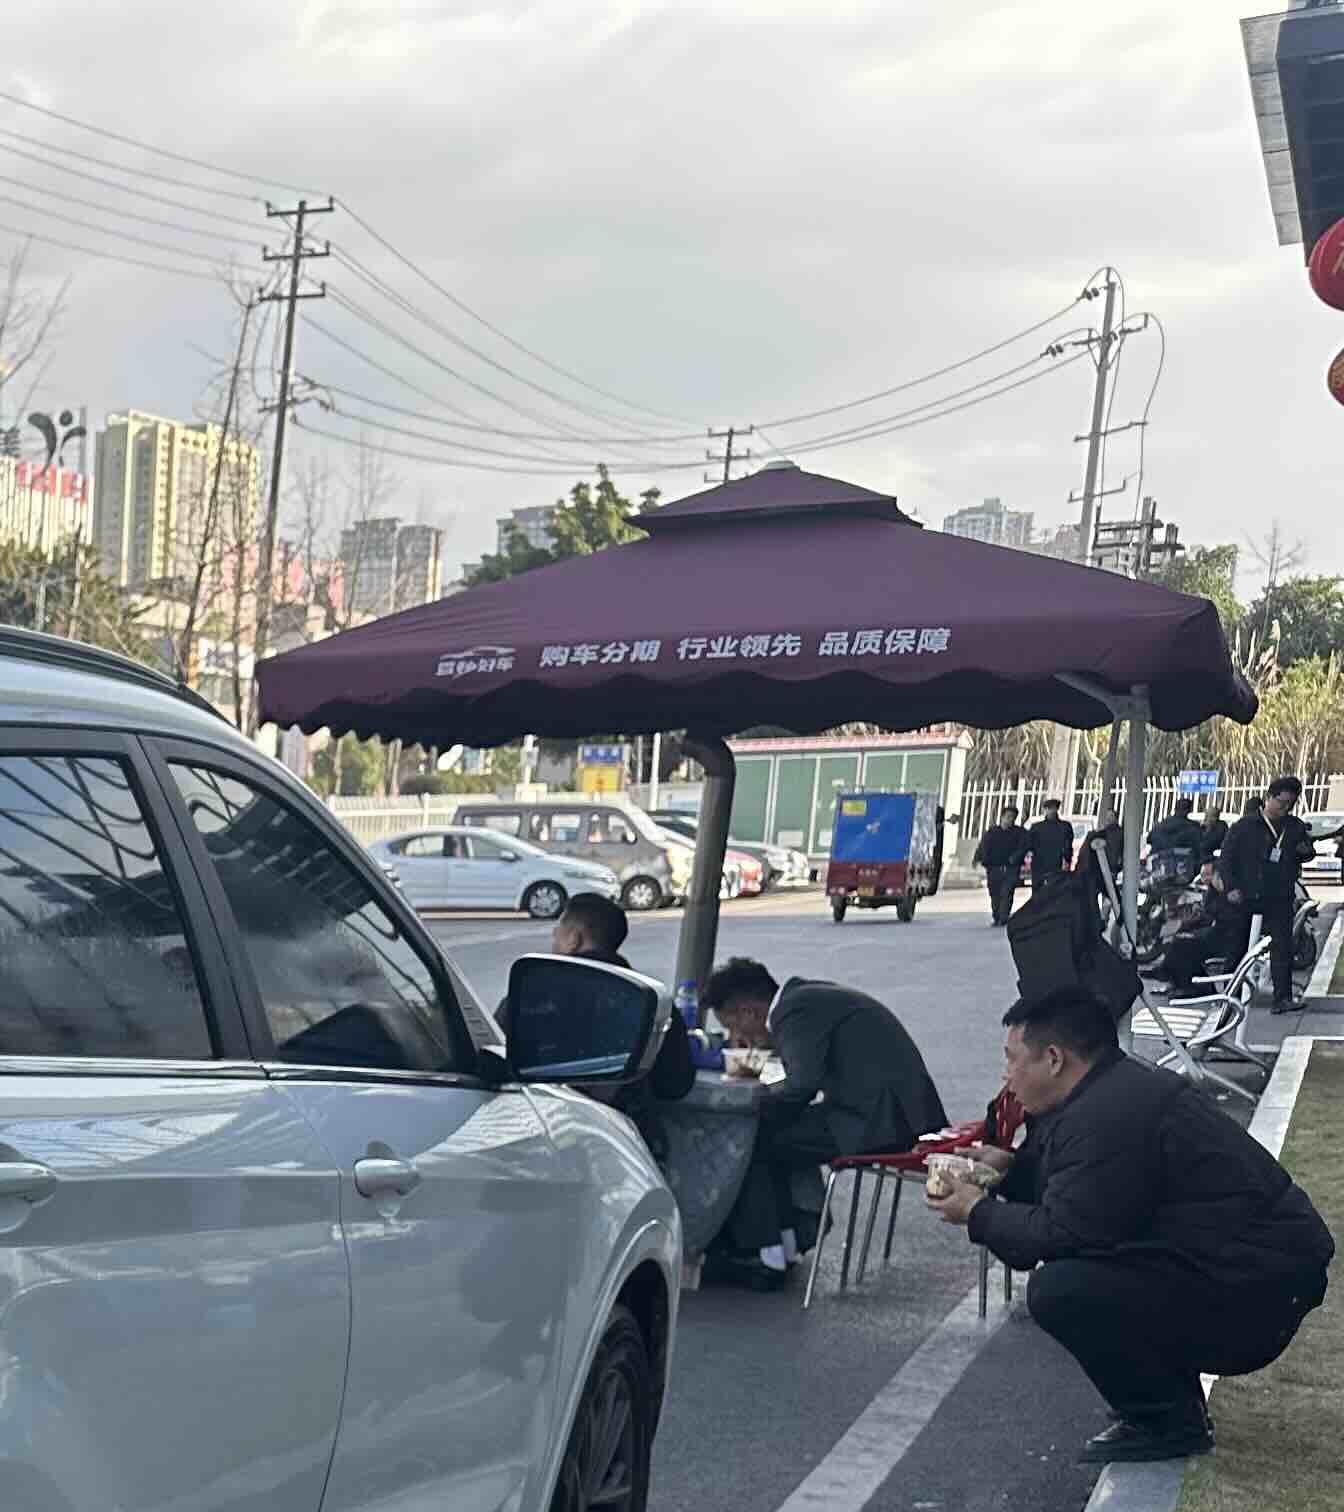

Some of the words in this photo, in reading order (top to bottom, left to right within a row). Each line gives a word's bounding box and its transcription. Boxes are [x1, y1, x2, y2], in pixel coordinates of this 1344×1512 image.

[539, 639, 661, 668] 购车分期
[677, 631, 802, 660] 行业领先
[818, 627, 951, 656] 品质保障
